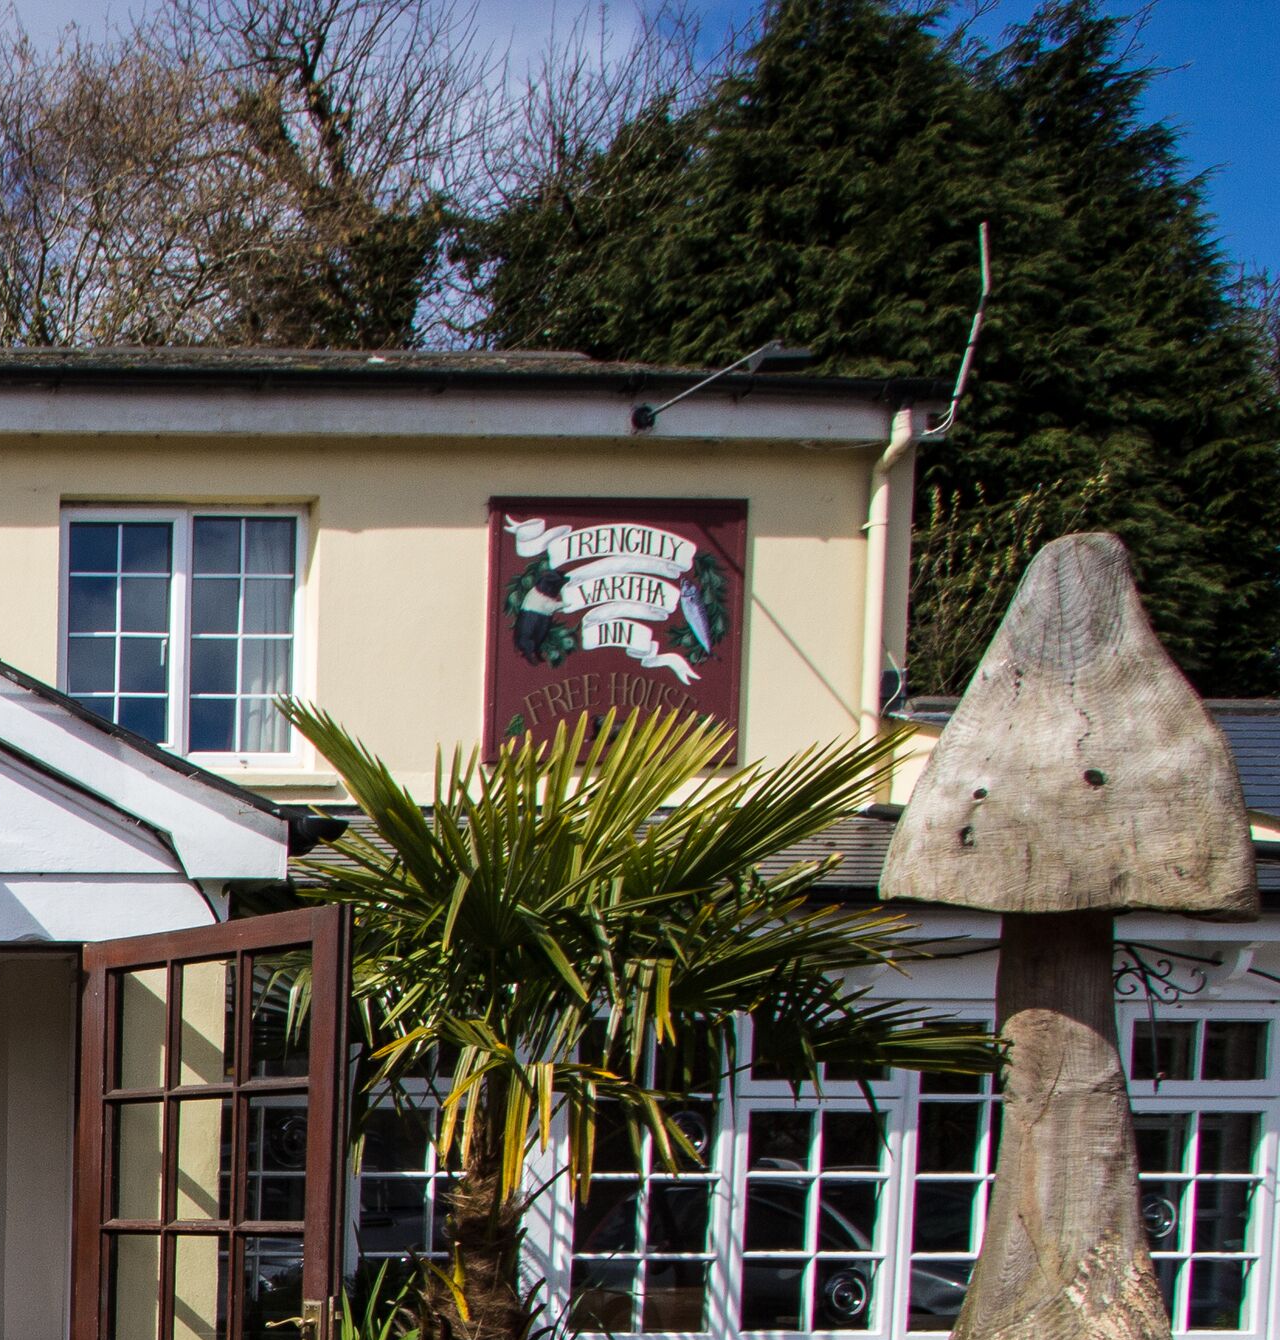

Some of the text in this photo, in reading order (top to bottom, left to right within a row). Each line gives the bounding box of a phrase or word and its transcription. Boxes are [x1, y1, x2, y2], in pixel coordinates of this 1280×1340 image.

[561, 527, 684, 561] TRENGILLY
[578, 577, 665, 606] WARTHA
[598, 623, 634, 645] INN
[523, 673, 600, 726] FREE
